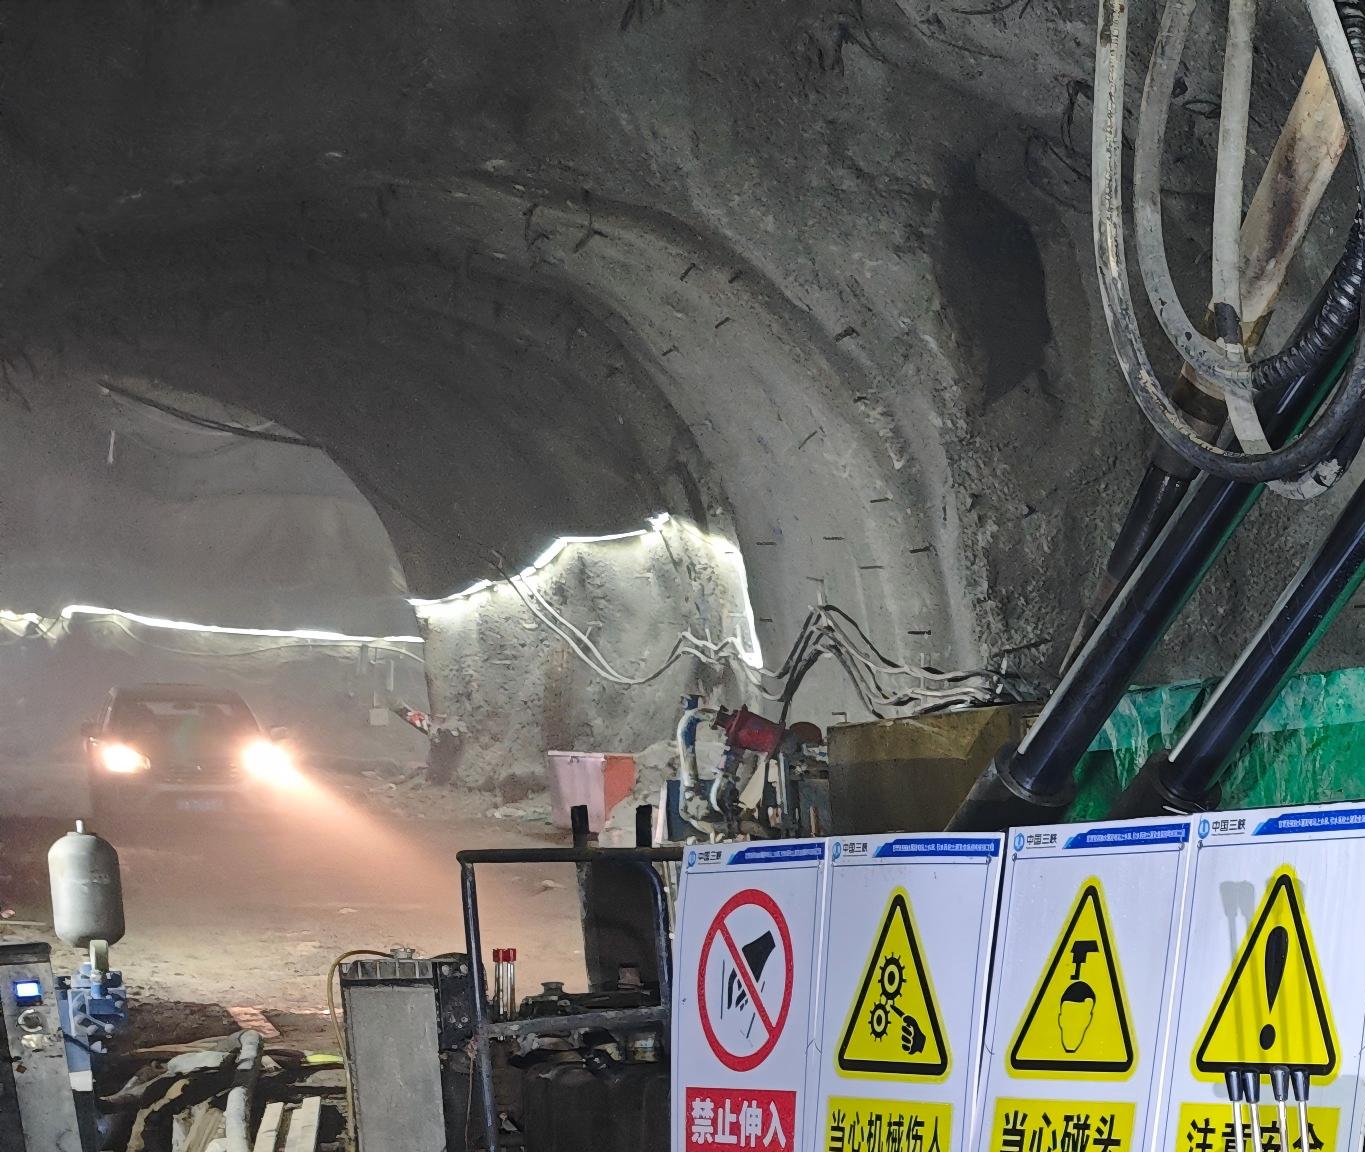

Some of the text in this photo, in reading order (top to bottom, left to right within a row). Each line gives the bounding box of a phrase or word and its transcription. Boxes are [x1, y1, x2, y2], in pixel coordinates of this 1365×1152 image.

[1211, 818, 1246, 832] 中国三峡
[691, 1097, 787, 1149] 禁止伸入
